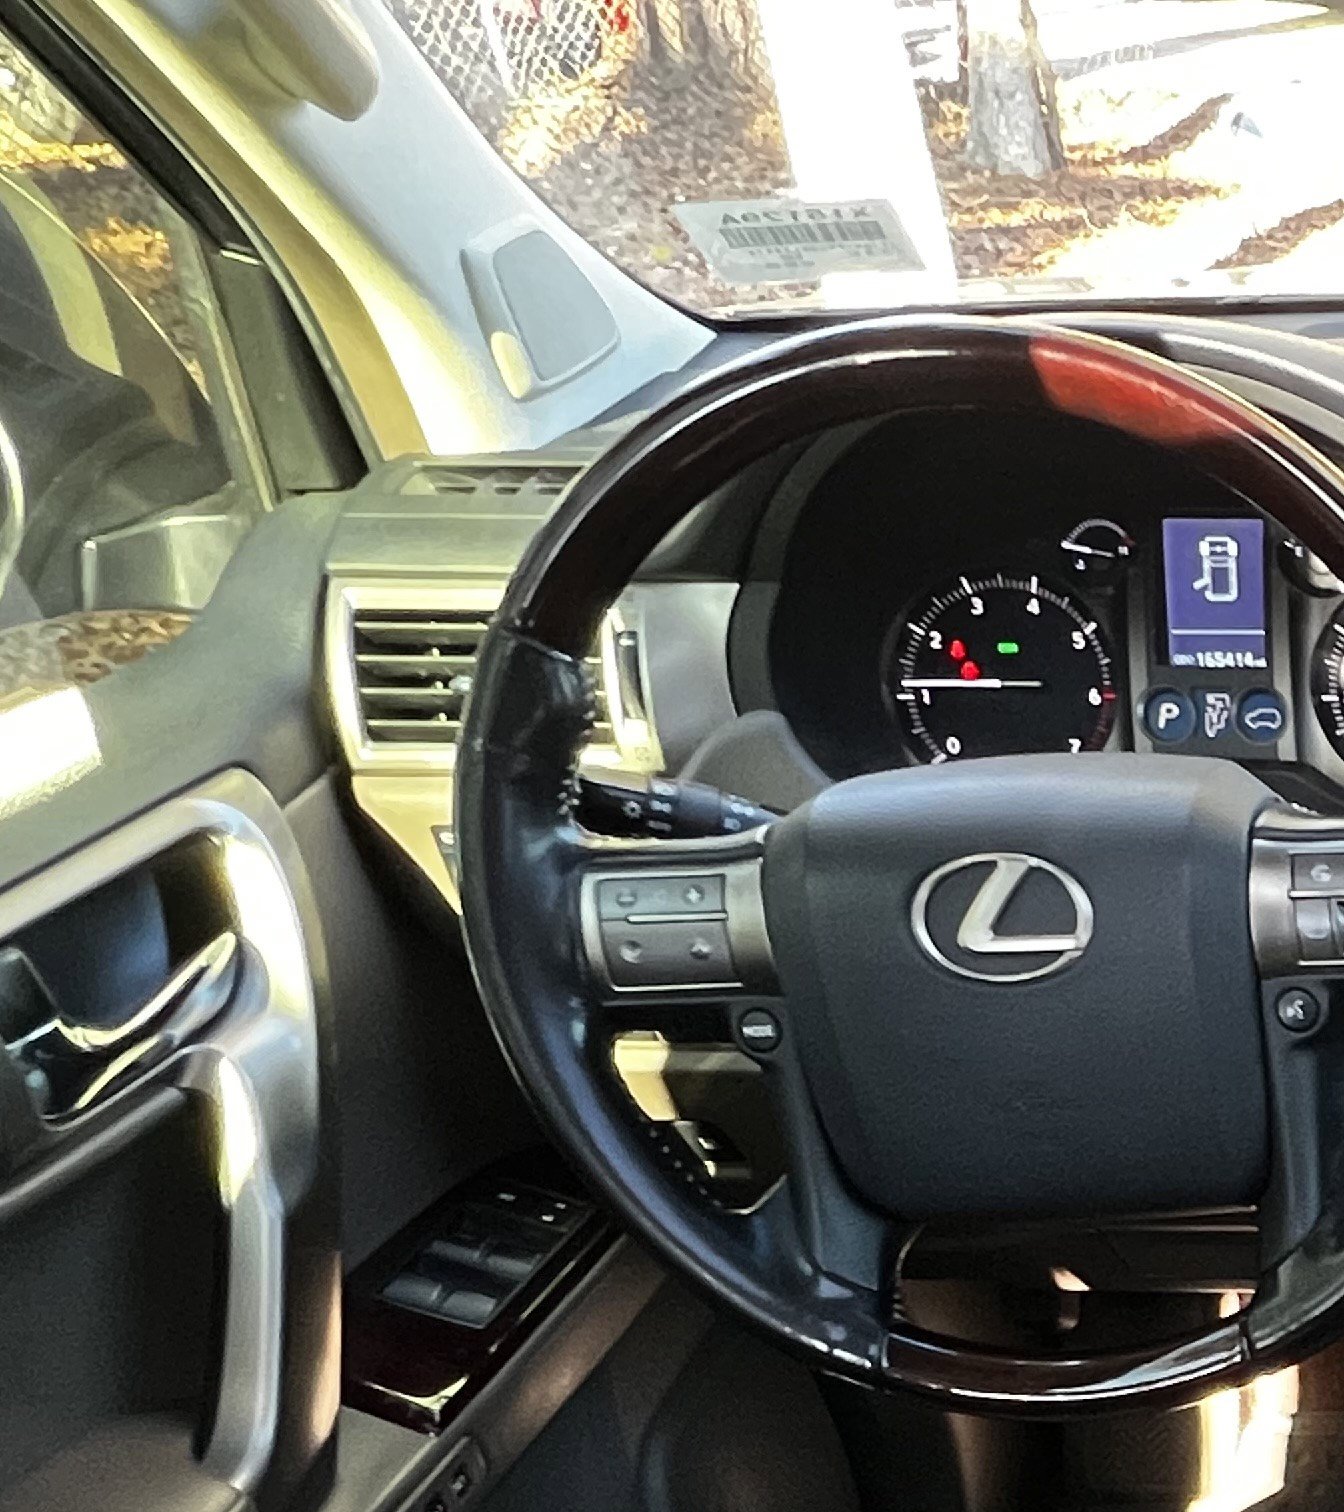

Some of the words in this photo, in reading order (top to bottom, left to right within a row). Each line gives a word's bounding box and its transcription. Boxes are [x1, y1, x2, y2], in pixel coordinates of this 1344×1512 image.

[970, 597, 984, 616] 3
[1026, 598, 1041, 616] 4
[929, 631, 943, 650] 2
[1072, 631, 1086, 650] 5
[1089, 688, 1102, 706] 6
[1157, 705, 1180, 729] P
[945, 736, 961, 755] 0
